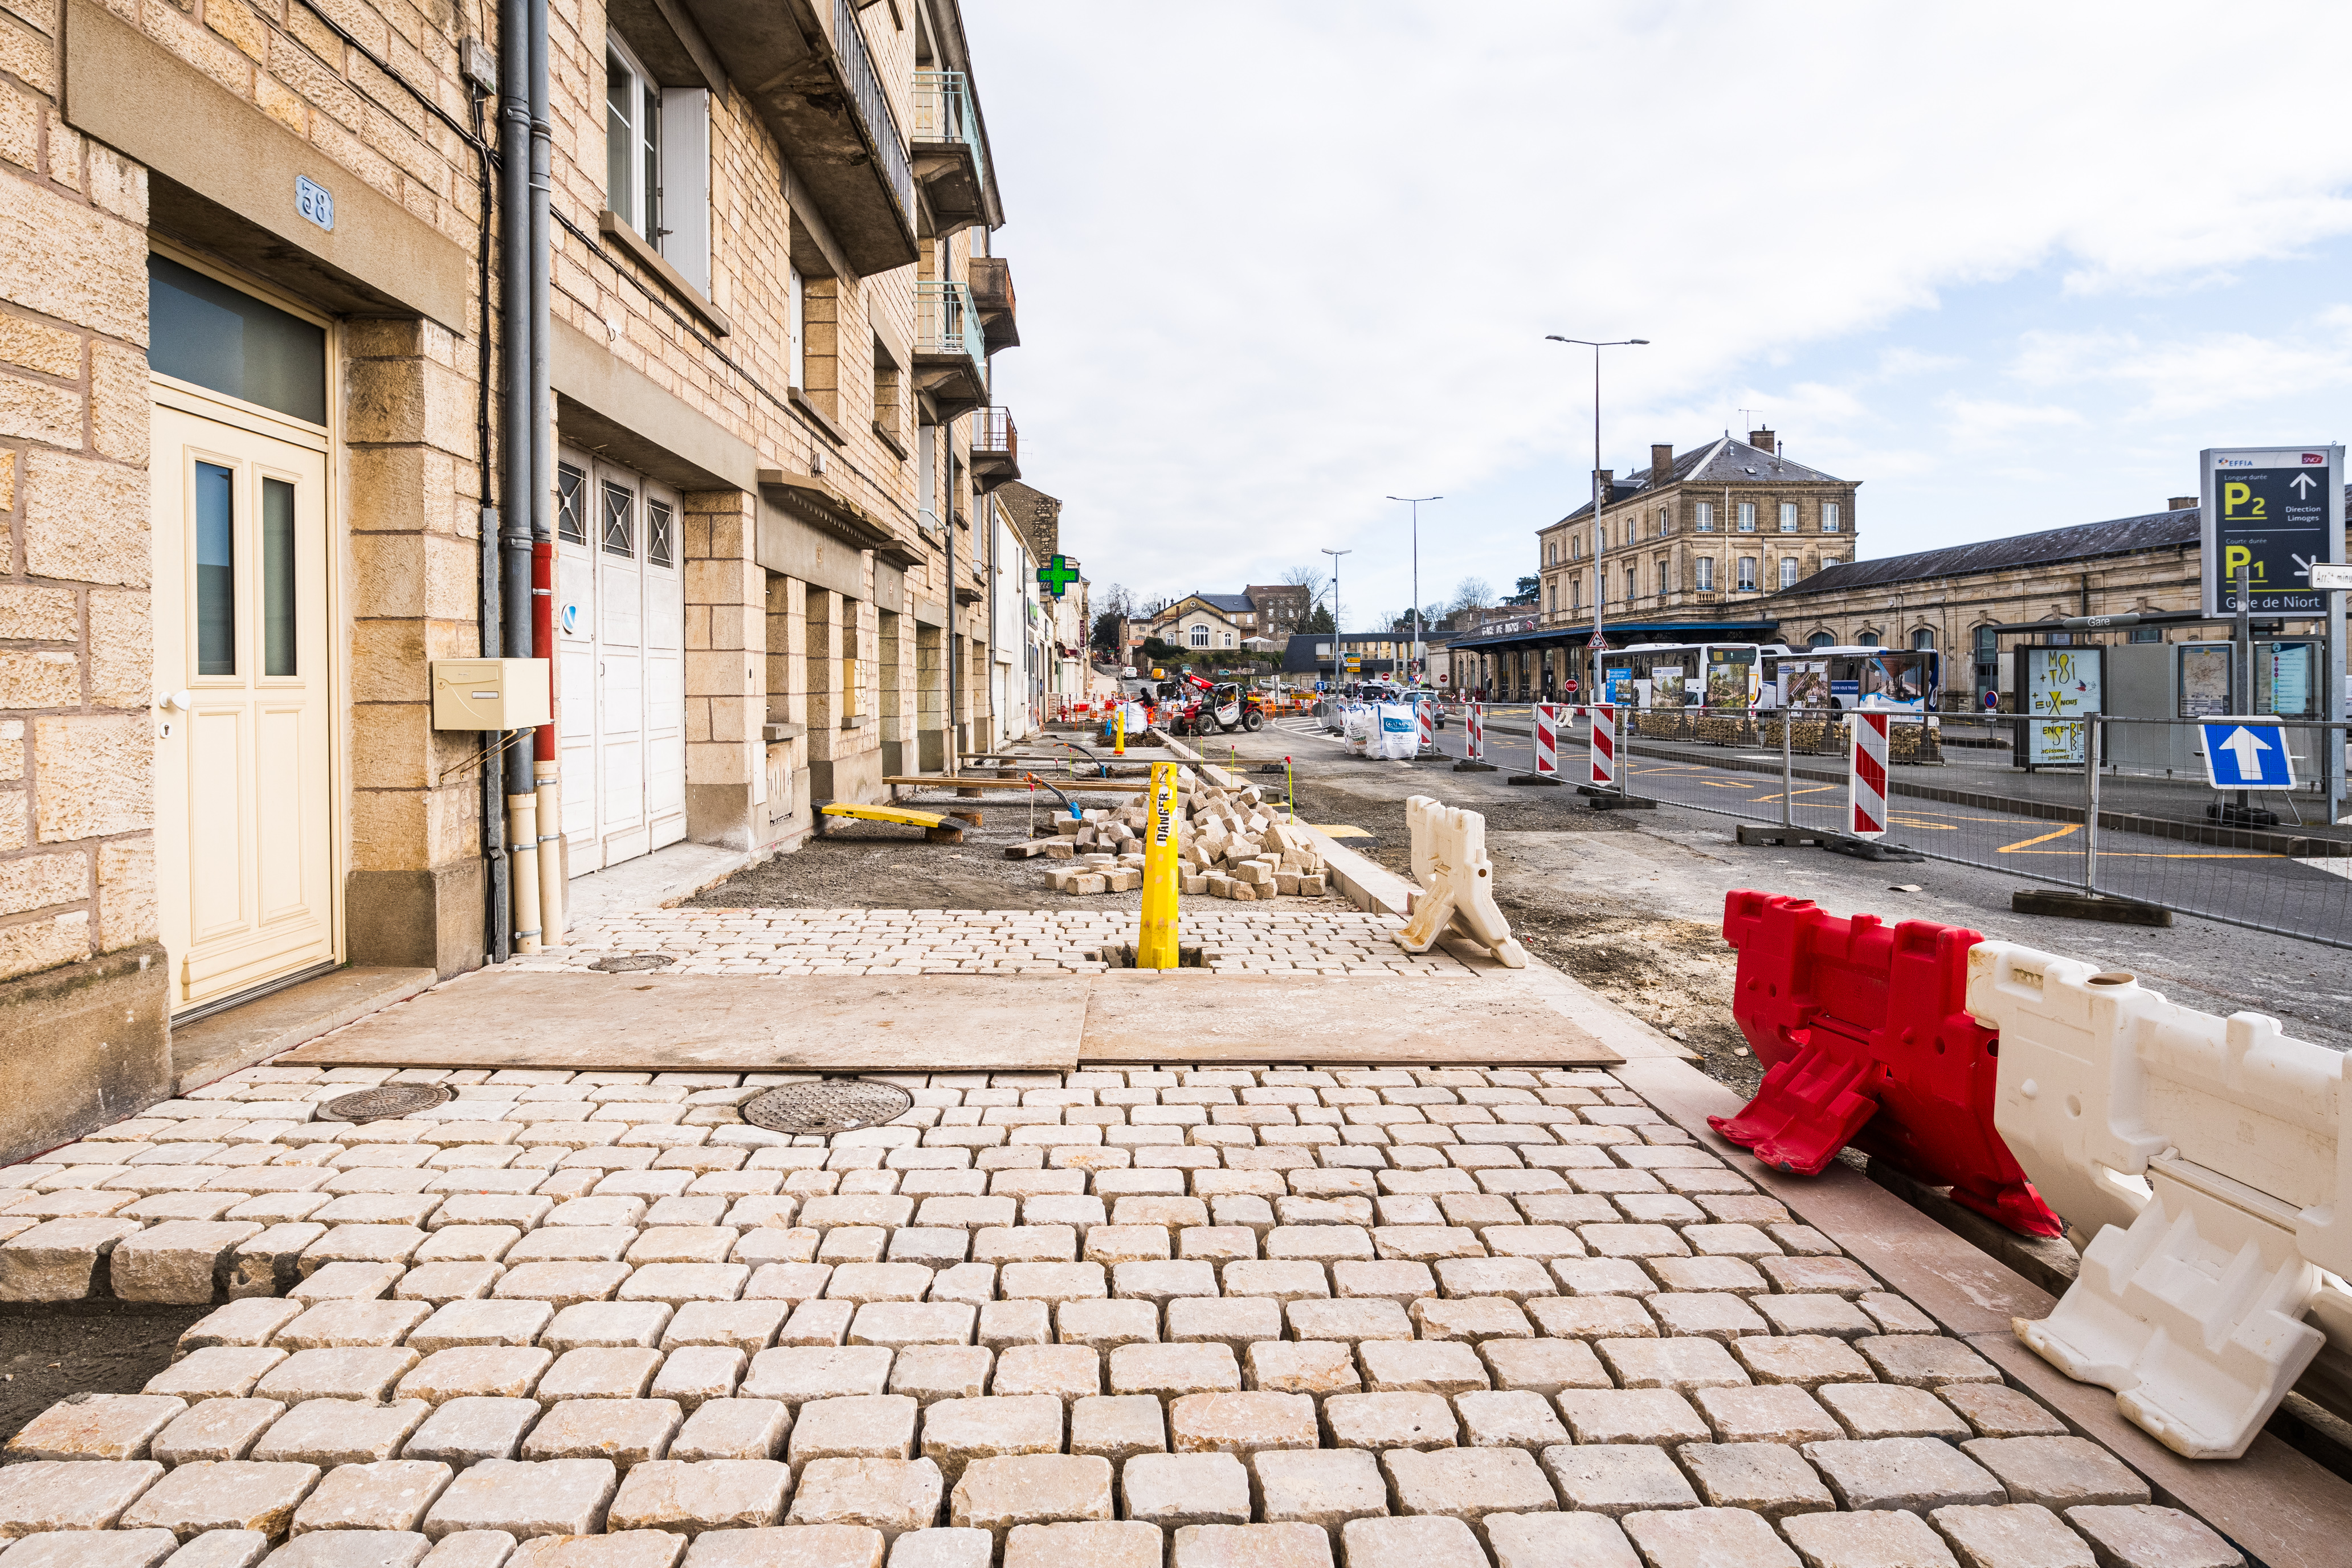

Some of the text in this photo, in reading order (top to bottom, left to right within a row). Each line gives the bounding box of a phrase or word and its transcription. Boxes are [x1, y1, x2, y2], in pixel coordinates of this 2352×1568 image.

[2224, 482, 2265, 516] P2
[2226, 545, 2264, 578] P1
[2226, 595, 2321, 609] Ge de Niort
[1496, 624, 1503, 634] DE
[2088, 617, 2110, 627] Gare
